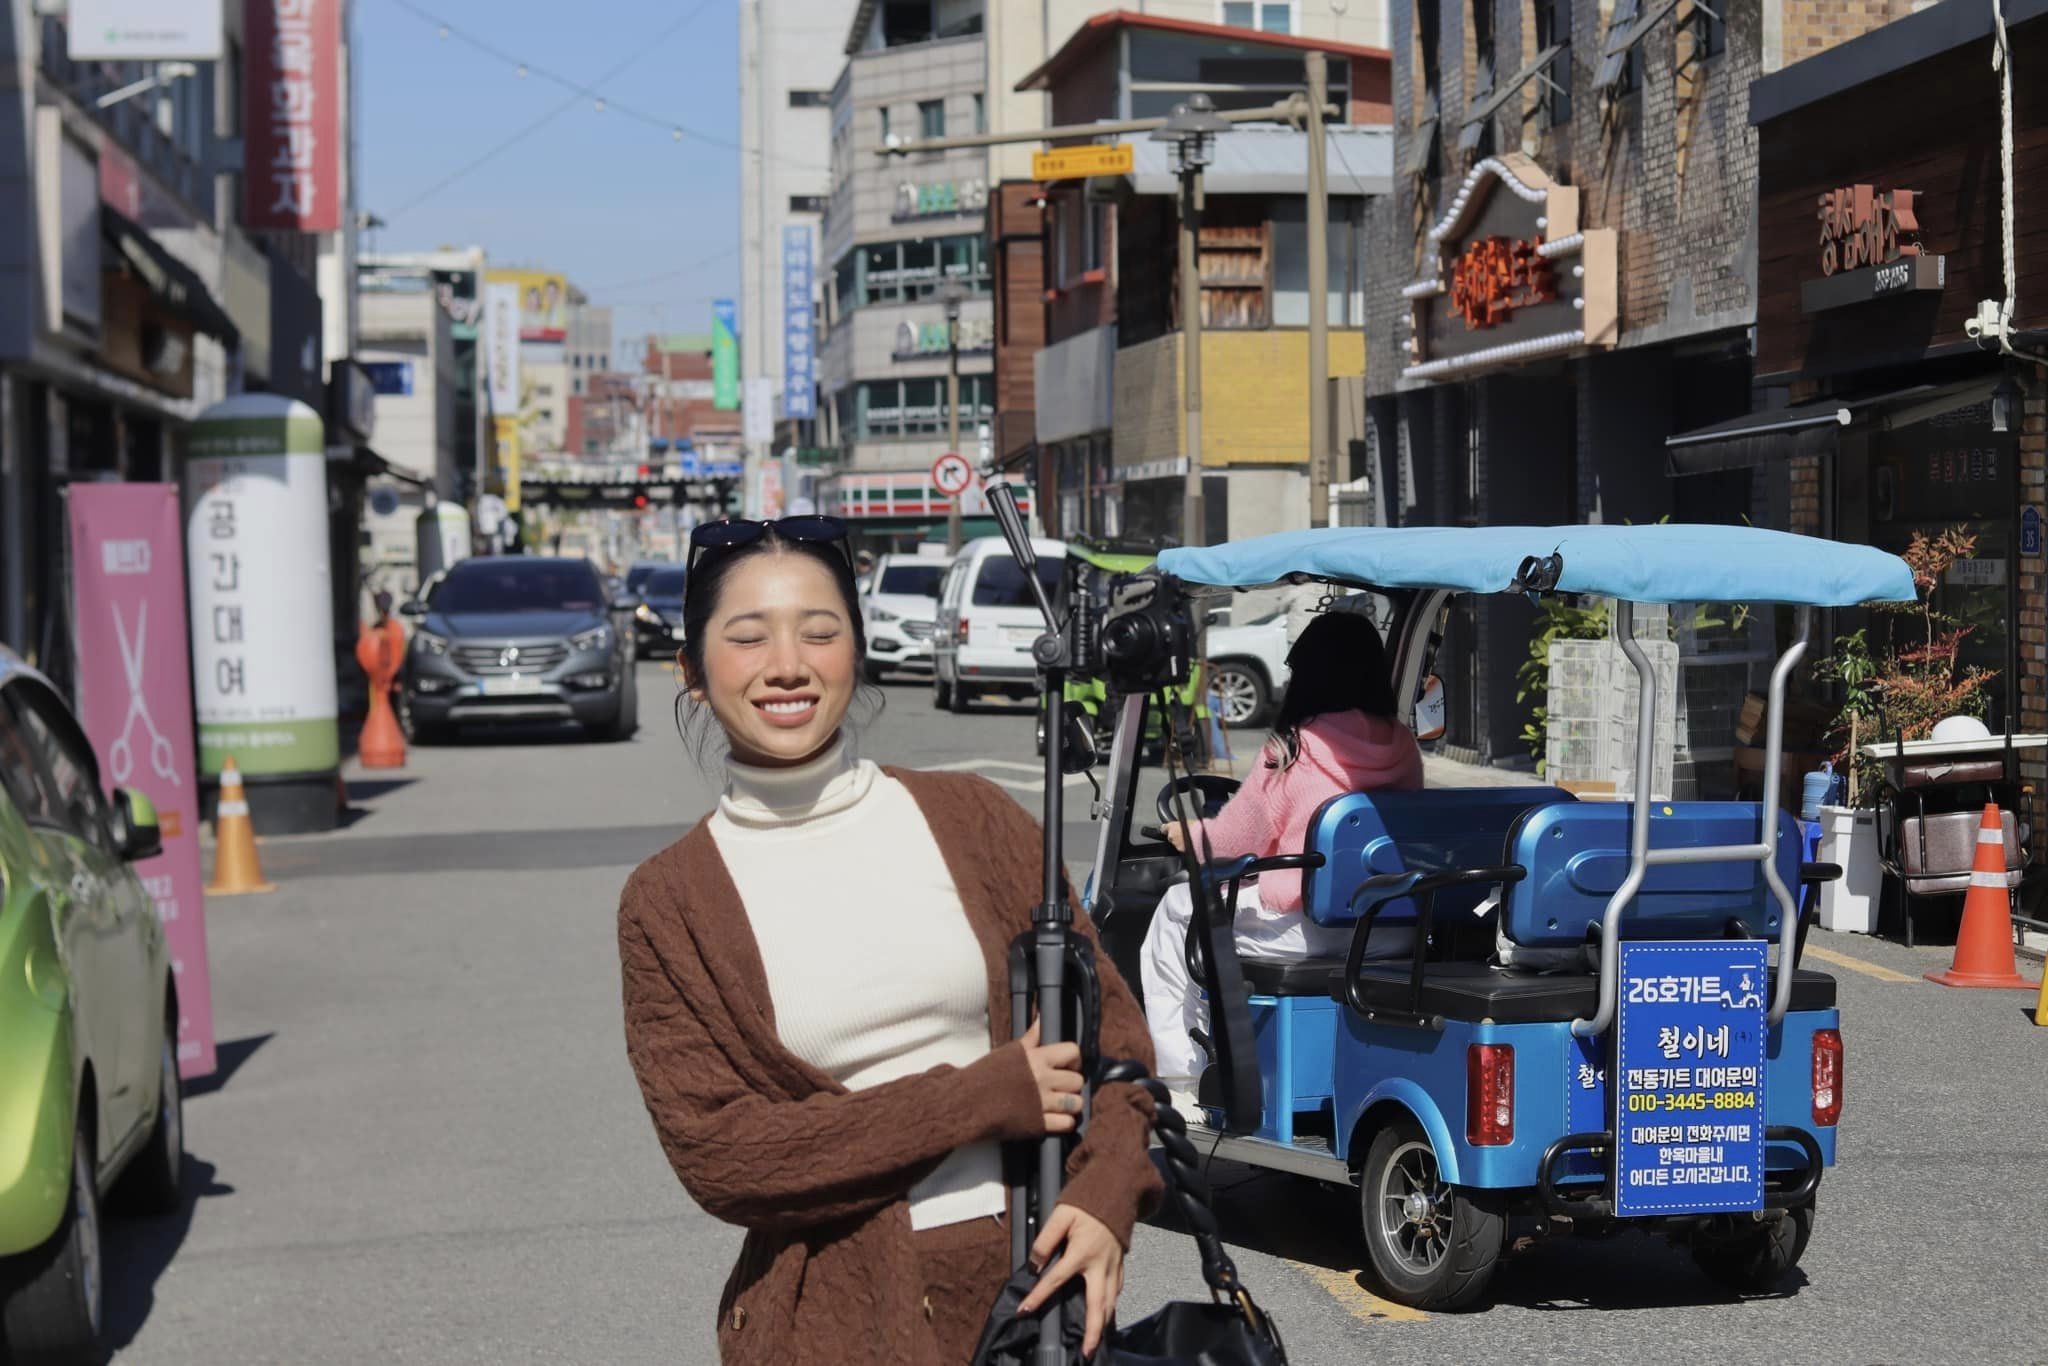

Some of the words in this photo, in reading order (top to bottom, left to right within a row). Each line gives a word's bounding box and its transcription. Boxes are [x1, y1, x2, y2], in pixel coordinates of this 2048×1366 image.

[207, 499, 247, 696] 공간대여
[1629, 975, 1721, 1003] 26호카트
[1657, 1024, 1729, 1059] 철이네
[1627, 1067, 1691, 1090] 전동카트
[1695, 1066, 1757, 1088] 대여문의
[1628, 1091, 1755, 1112] 010-3445-8884
[1631, 1125, 1683, 1144] 대여문의
[1686, 1123, 1751, 1143] 전화주시면
[1659, 1145, 1724, 1165] 한옥마을내
[1629, 1168, 1669, 1187] 어디든
[1672, 1165, 1752, 1185] 모시러갑니다.
